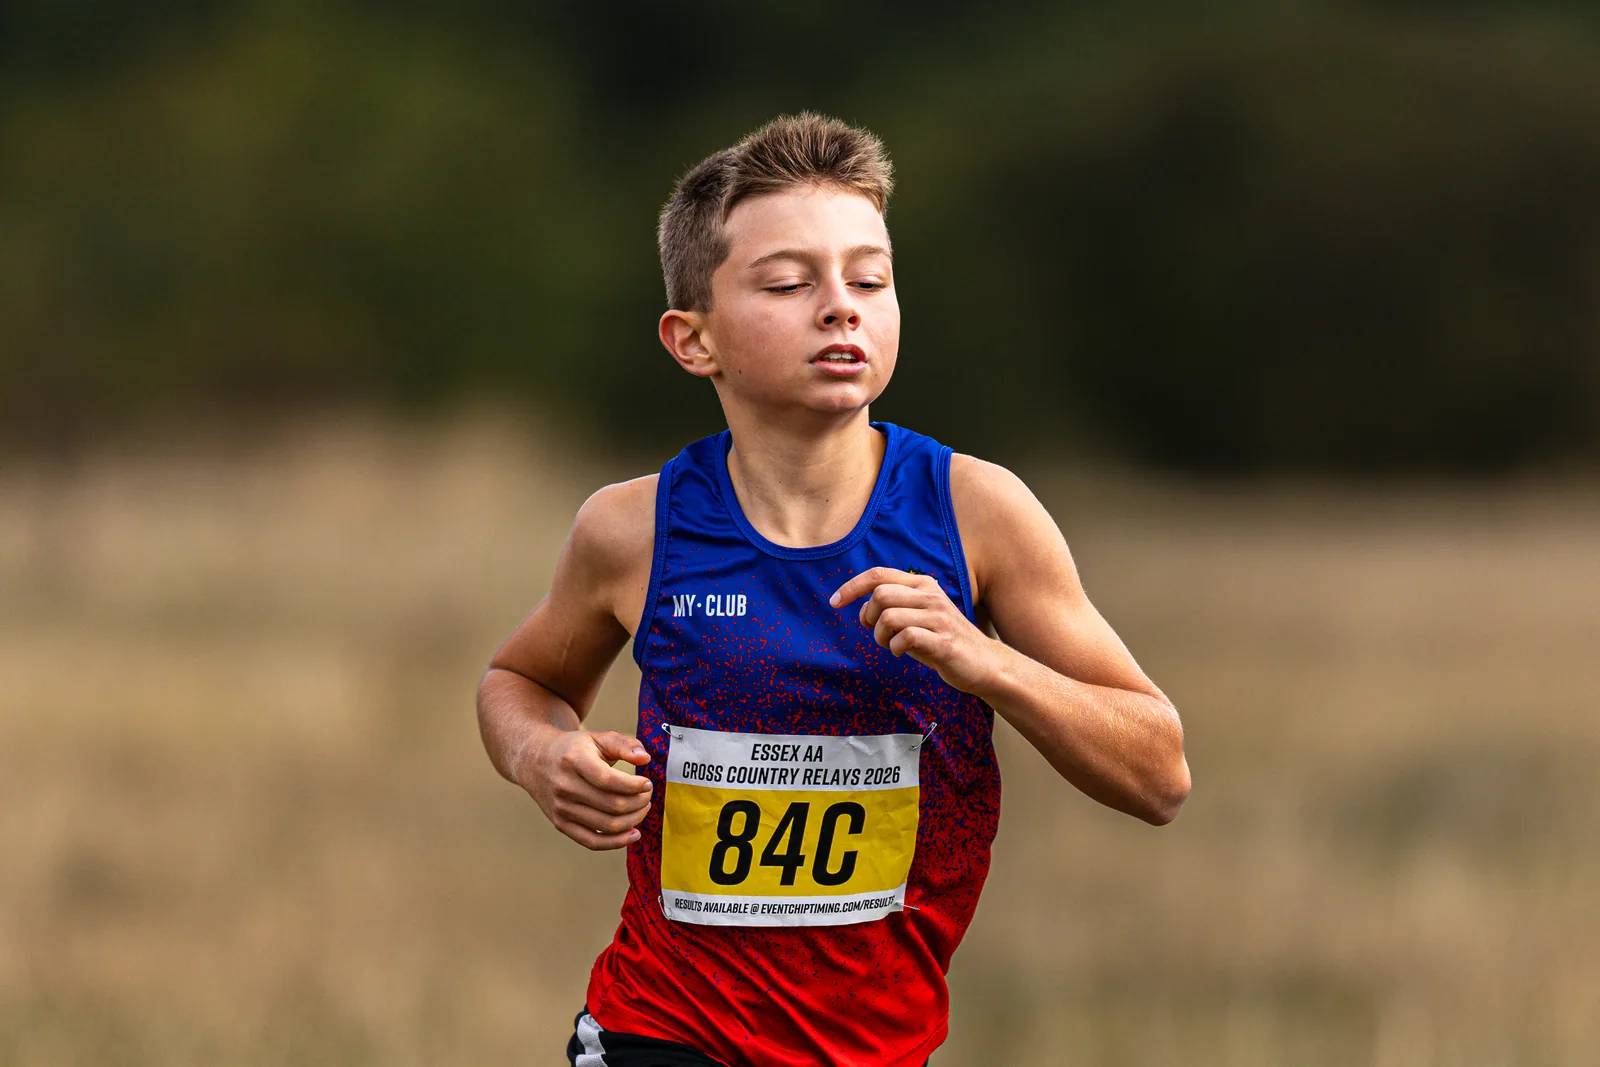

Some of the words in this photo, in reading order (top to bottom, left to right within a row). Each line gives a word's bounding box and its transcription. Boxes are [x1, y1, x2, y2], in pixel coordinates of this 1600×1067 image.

[751, 743, 800, 762] ESSEX
[803, 745, 823, 763] AA
[682, 761, 723, 783] CROSS
[726, 766, 799, 785] COUNTRY
[802, 768, 860, 786] RELAYS
[863, 766, 900, 785] 2026
[708, 799, 866, 886] 84C
[675, 898, 702, 912] RESULTS
[703, 902, 748, 914] AVAILABLE
[750, 904, 759, 915] @
